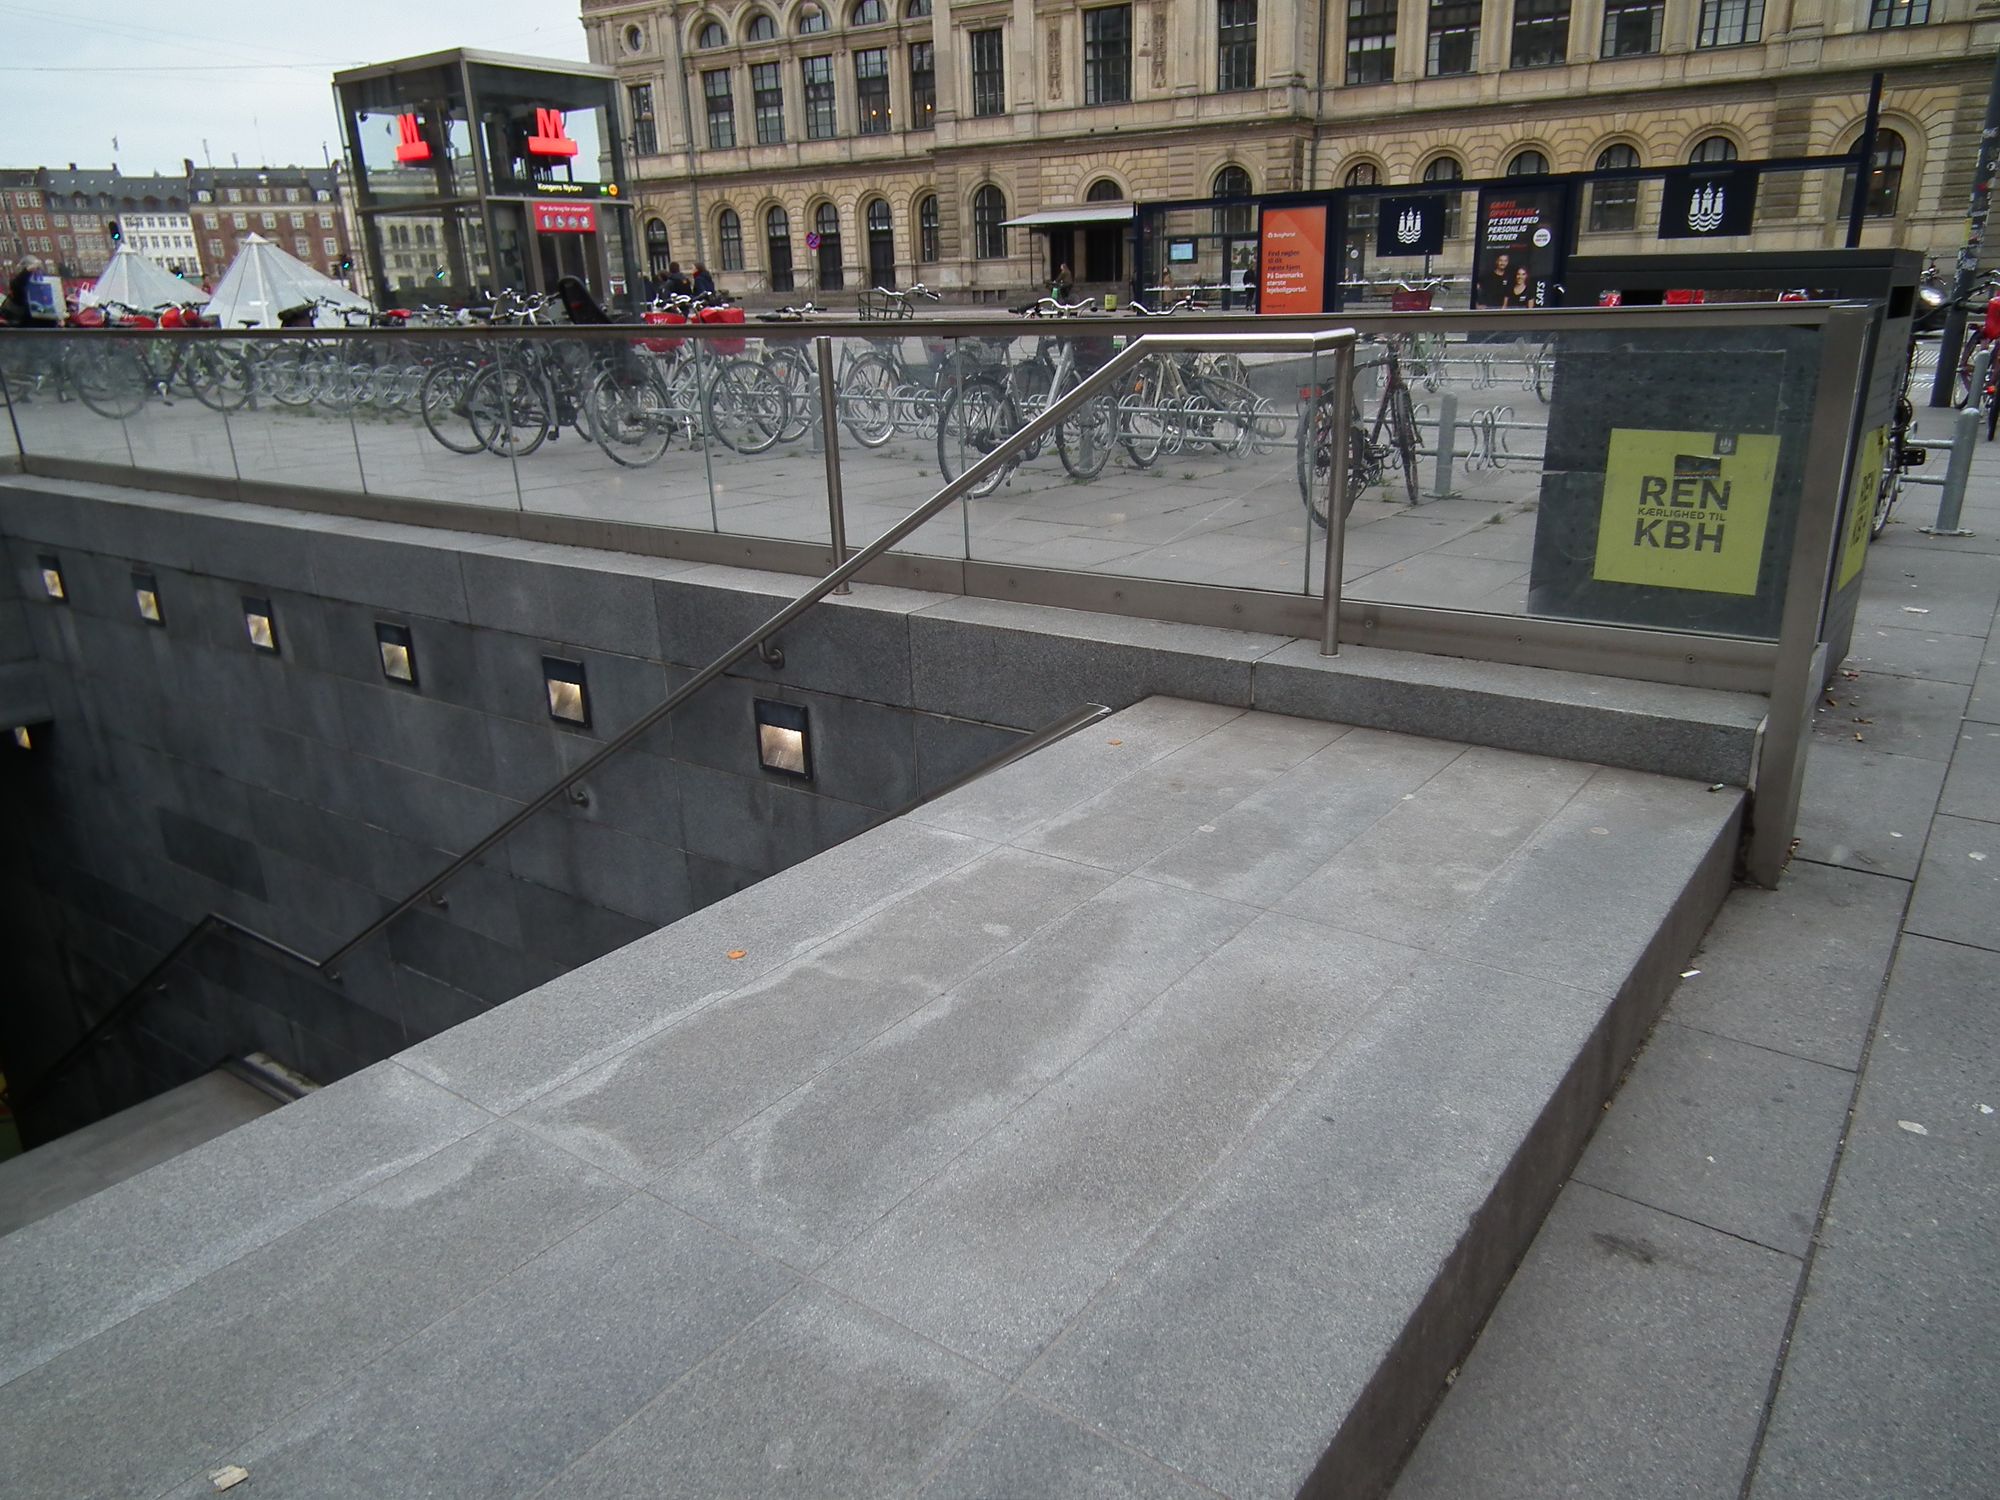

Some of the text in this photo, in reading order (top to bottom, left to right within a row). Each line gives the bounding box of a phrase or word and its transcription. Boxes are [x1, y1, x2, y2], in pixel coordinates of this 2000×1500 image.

[537, 182, 584, 194] Kongens Nytorv
[1487, 216, 1540, 226] PT START MED
[1487, 225, 1528, 234] PERSONLIG
[1487, 233, 1518, 242] TRÆNER
[1536, 281, 1546, 306] SATS
[1639, 475, 1732, 511] REN
[1637, 507, 1727, 522] KÆRLIGHED TIL
[1633, 517, 1726, 554] KBH
